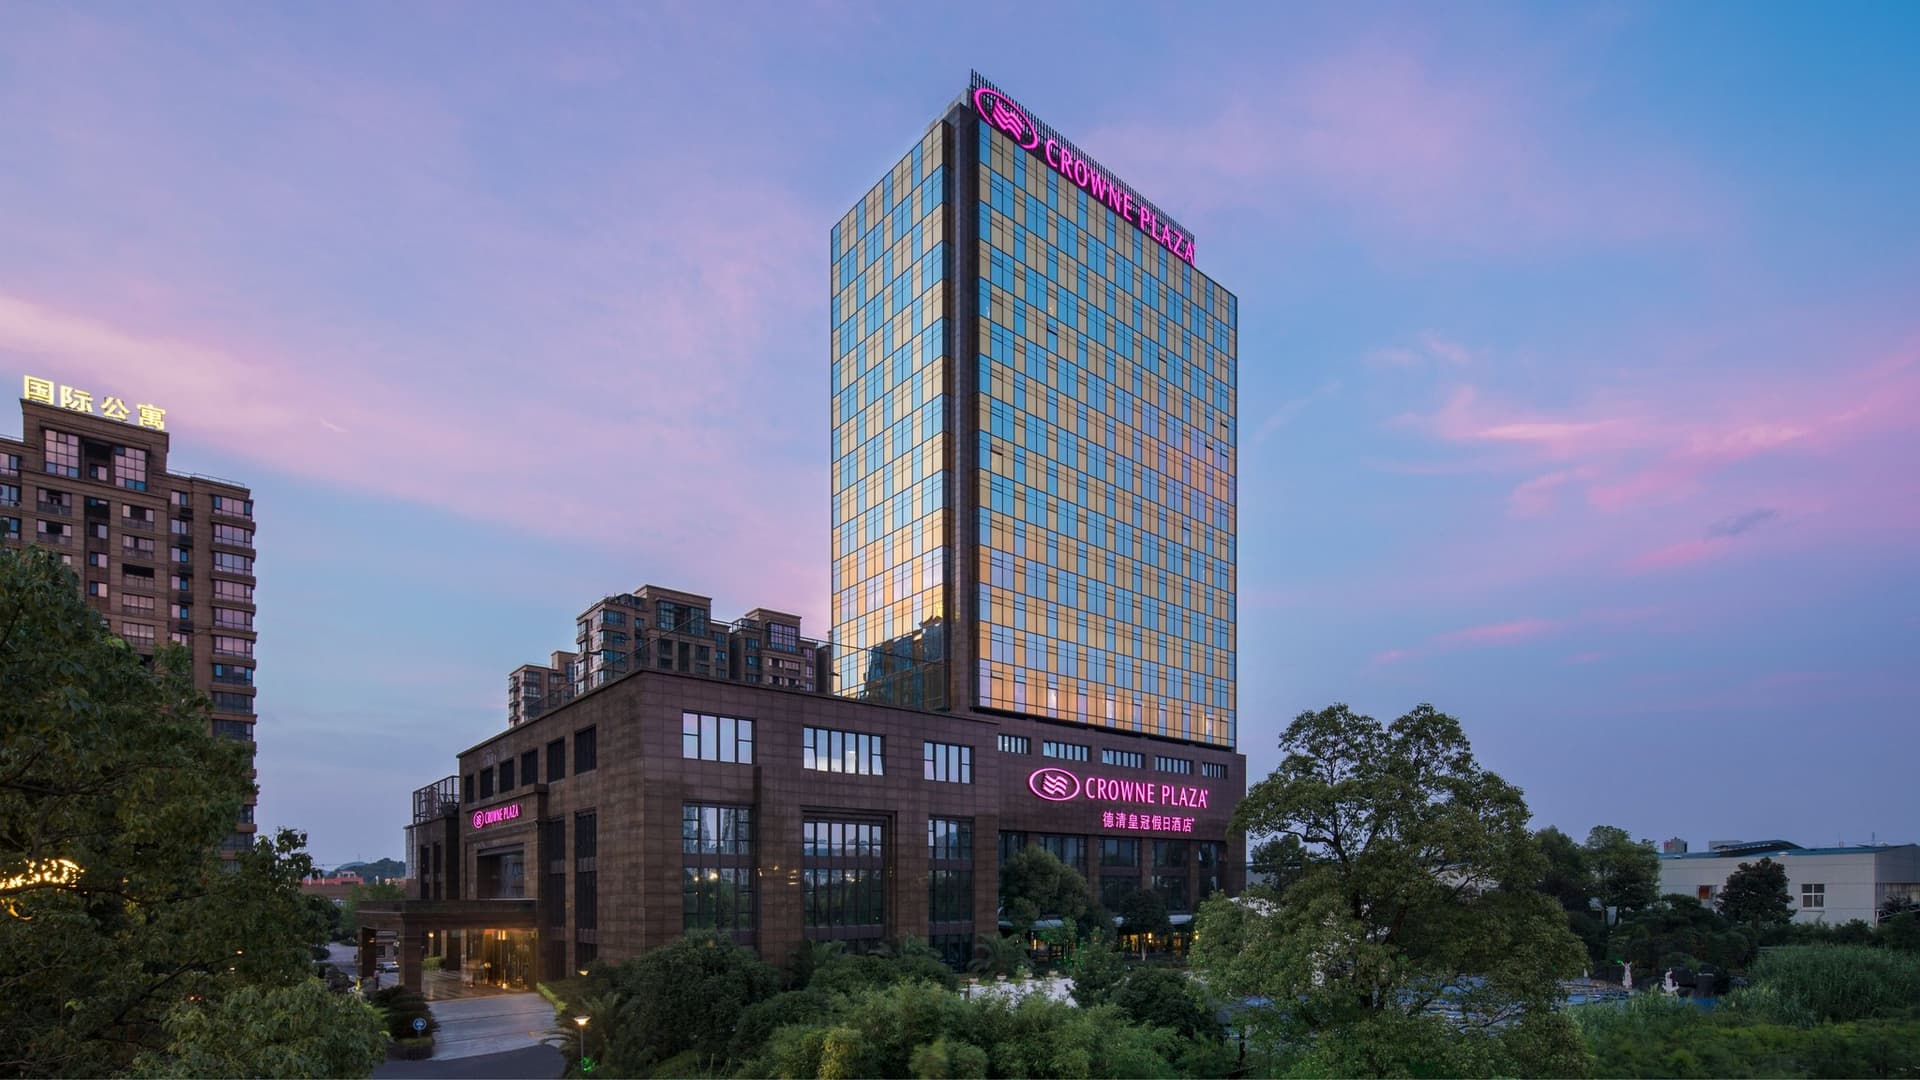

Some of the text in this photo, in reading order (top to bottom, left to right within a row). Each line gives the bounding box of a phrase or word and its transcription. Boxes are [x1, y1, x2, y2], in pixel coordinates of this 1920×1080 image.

[1045, 139, 1196, 267] CROWNE PLAZA
[24, 375, 166, 431] 国际公寓
[1085, 777, 1208, 808] CROWNE PLAZA
[485, 805, 518, 823] CROWNE PLAZA
[1102, 811, 1193, 833] 德清皇冠假日酒店
